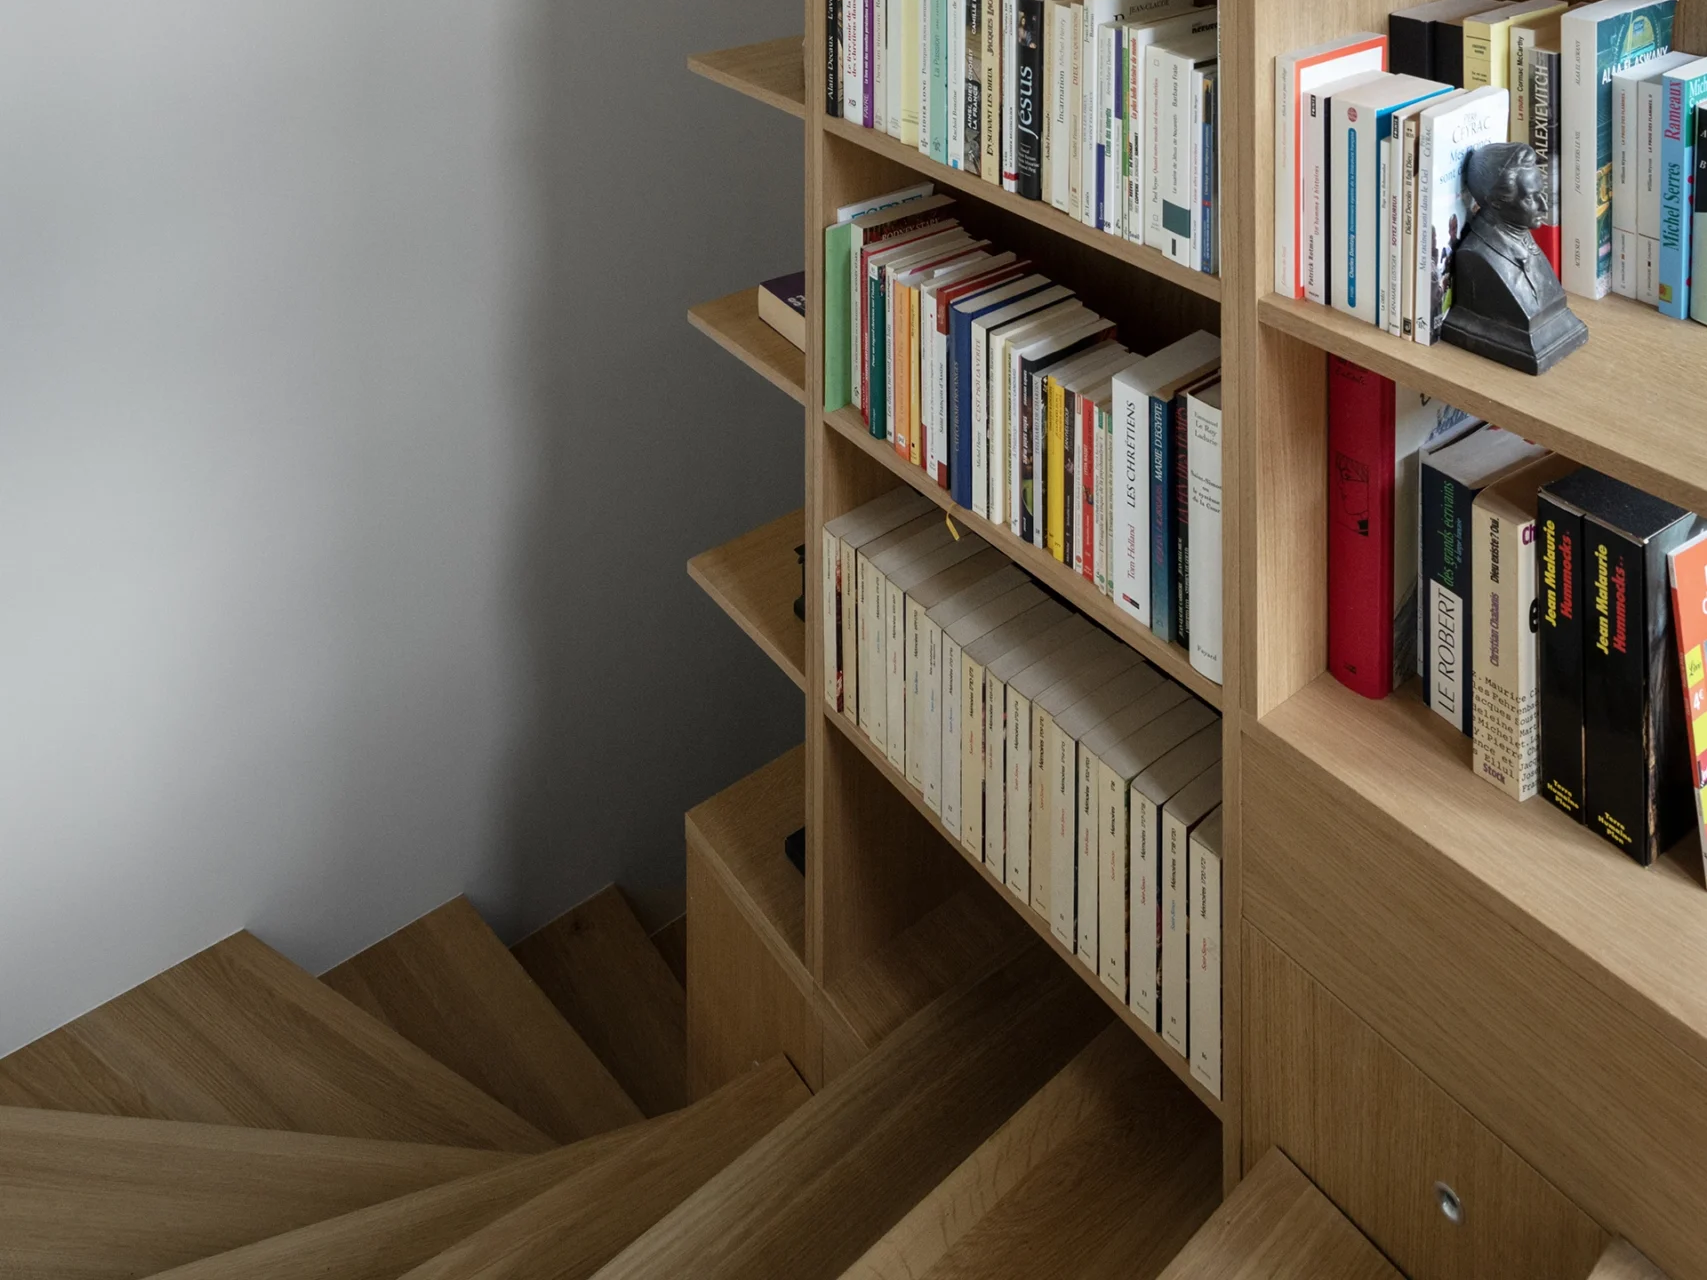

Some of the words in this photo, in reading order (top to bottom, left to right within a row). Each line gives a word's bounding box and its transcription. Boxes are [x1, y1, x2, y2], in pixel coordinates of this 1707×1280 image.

[1516, 36, 1525, 66] McCarthy
[934, 67, 940, 77] La
[1017, 66, 1039, 139] Jésus
[1057, 70, 1065, 124] Incarnation
[1664, 81, 1681, 141] Rameaux
[972, 121, 977, 130] LA
[1131, 111, 1137, 120] La
[1517, 113, 1523, 121] La
[1534, 65, 1549, 159] ALEXIEVITCH
[987, 144, 993, 156] EN
[1423, 126, 1431, 157] CEYRAC
[1421, 169, 1429, 185] Ciel
[1663, 163, 1680, 202] Serres
[1420, 194, 1428, 210] dans
[1314, 226, 1320, 235] Un
[1663, 207, 1680, 251] Michel
[975, 369, 981, 381] LA
[1124, 401, 1136, 482] CHRÉTIENS
[1205, 425, 1217, 437] Roy
[1154, 450, 1163, 481] MARIE
[1127, 486, 1136, 508] LES
[1438, 480, 1454, 528] écrivains
[1490, 517, 1499, 533] Oui.
[1127, 524, 1136, 560] Holland
[1437, 530, 1457, 568] grands
[1543, 520, 1556, 589] Malaurie
[1127, 562, 1135, 580] Tom
[1440, 569, 1454, 586] des
[1489, 564, 1499, 583] Dieu
[1558, 535, 1572, 619] Hummocks
[1594, 544, 1608, 615] Malaurie
[1489, 592, 1499, 630] Chabanis
[1545, 589, 1556, 627] Jean
[1611, 566, 1626, 653] Hummocks
[1438, 587, 1455, 681] ROBERT
[1596, 616, 1609, 655] Jean
[1489, 631, 1499, 667] Christian
[1438, 682, 1455, 713] LE
[1485, 676, 1526, 704] Maurice
[1488, 734, 1522, 760] Pierre
[1483, 763, 1505, 784] Stock
[1554, 779, 1572, 797] Terre
[1547, 782, 1579, 809] Humaine
[1555, 794, 1571, 811] Plon
[1598, 815, 1632, 844] Humaine
[1604, 812, 1625, 830] Terre
[1607, 828, 1624, 845] Plon
